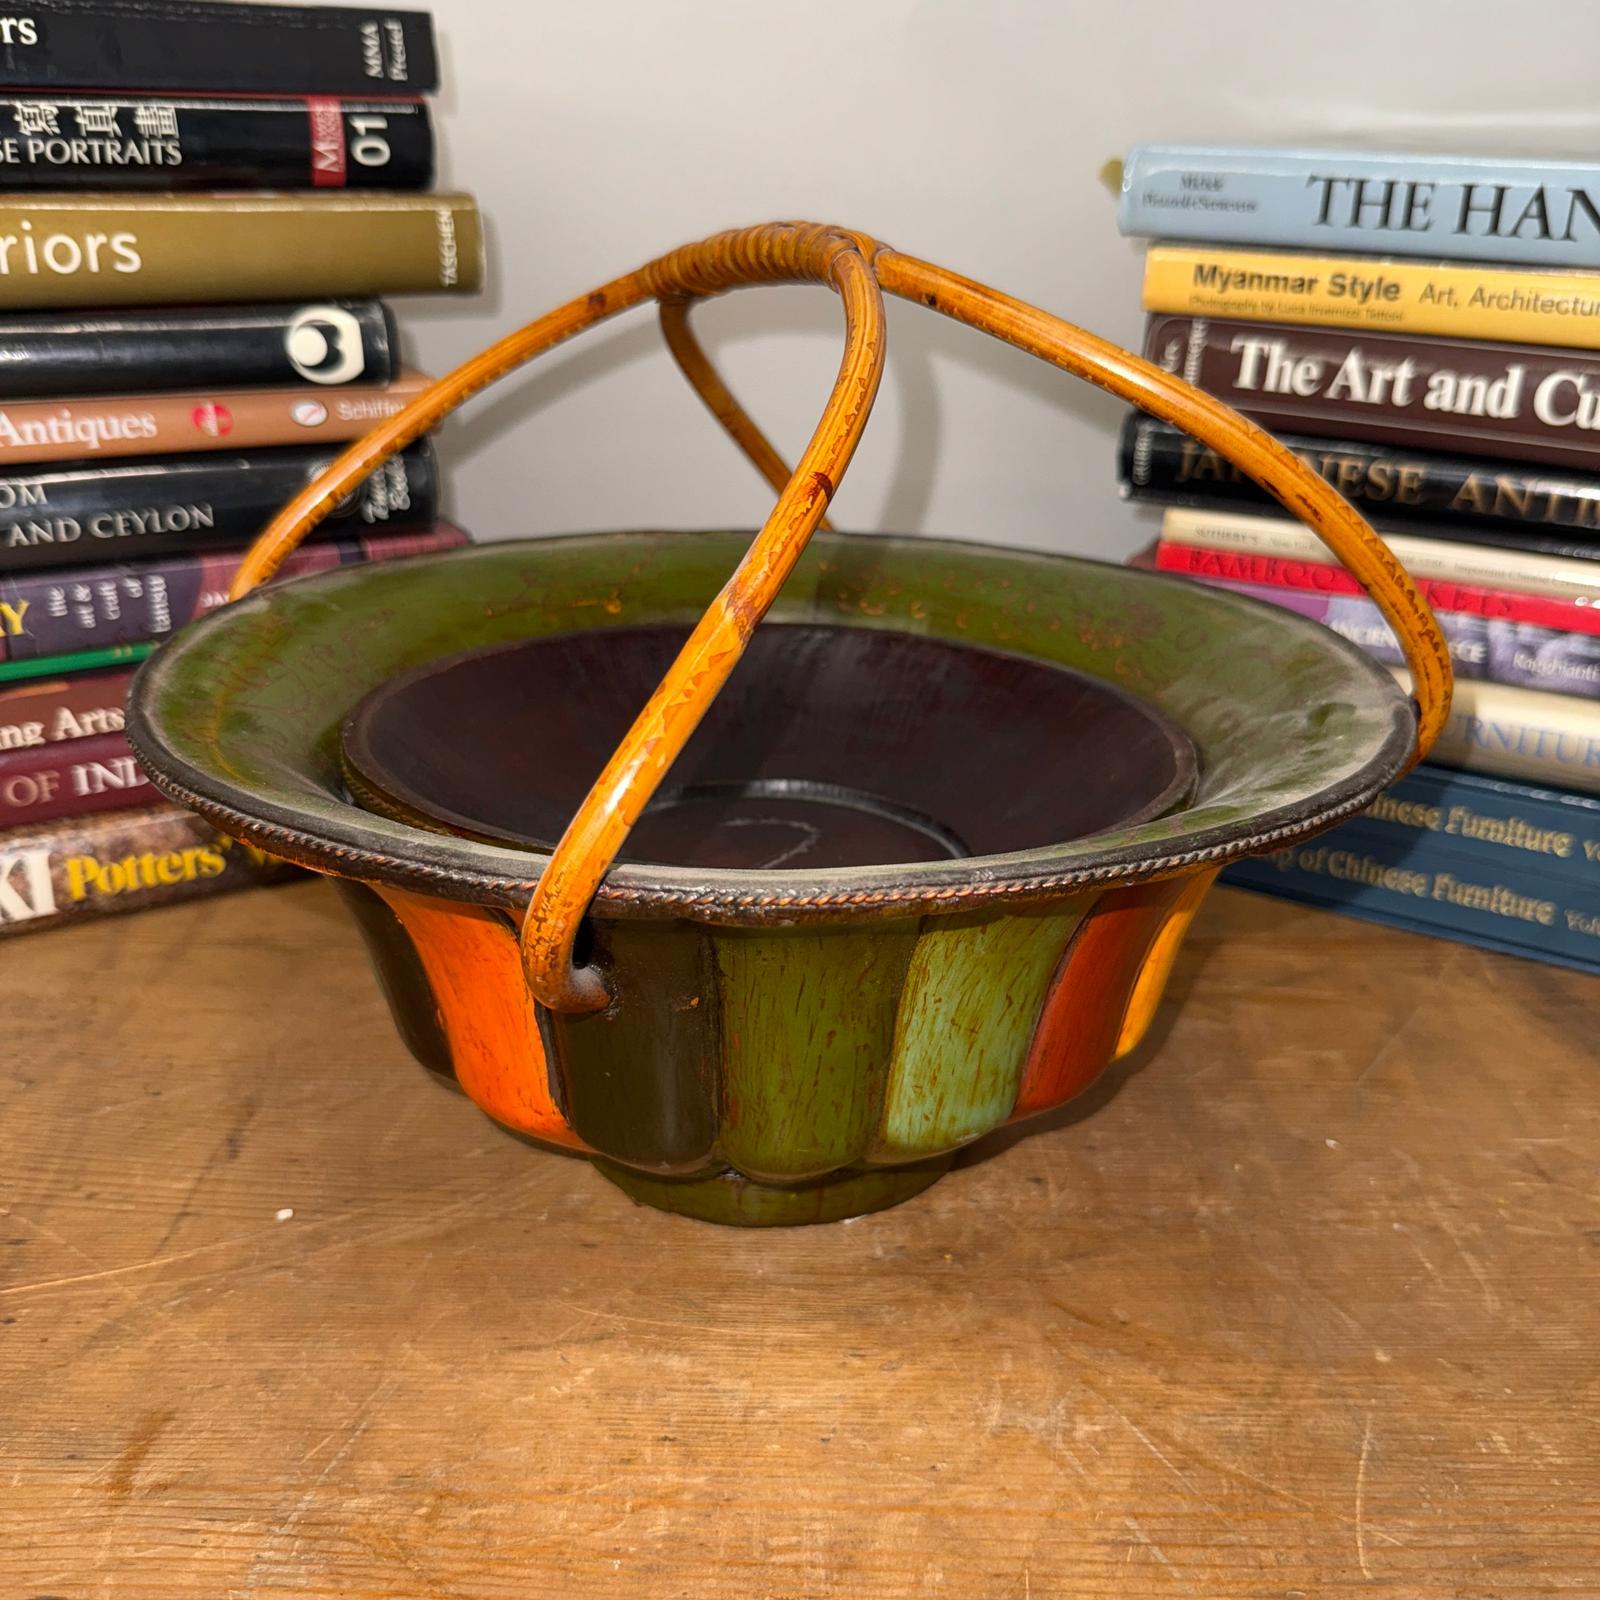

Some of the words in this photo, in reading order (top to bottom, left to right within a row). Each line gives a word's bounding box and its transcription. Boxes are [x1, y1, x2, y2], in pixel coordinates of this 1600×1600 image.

[27, 137, 183, 166] PORTRAITS
[348, 114, 391, 166] 01
[1306, 171, 1436, 233] THE
[0, 219, 142, 274] riors
[1193, 263, 1319, 294] Myanmar
[1327, 271, 1400, 304] Style
[1418, 281, 1459, 308] Art,
[1231, 335, 1322, 396] The
[1324, 348, 1415, 407] Art
[1424, 364, 1525, 420] and
[0, 409, 157, 449] Antiques
[9, 517, 82, 548] AND
[88, 502, 214, 539] CEYLON
[1448, 472, 1600, 526] ANTI
[51, 707, 125, 741] Arts
[4, 770, 61, 807] OF
[1444, 805, 1575, 857] Furniture
[1328, 849, 1429, 898] Chinese
[1432, 873, 1557, 926] Furniture
